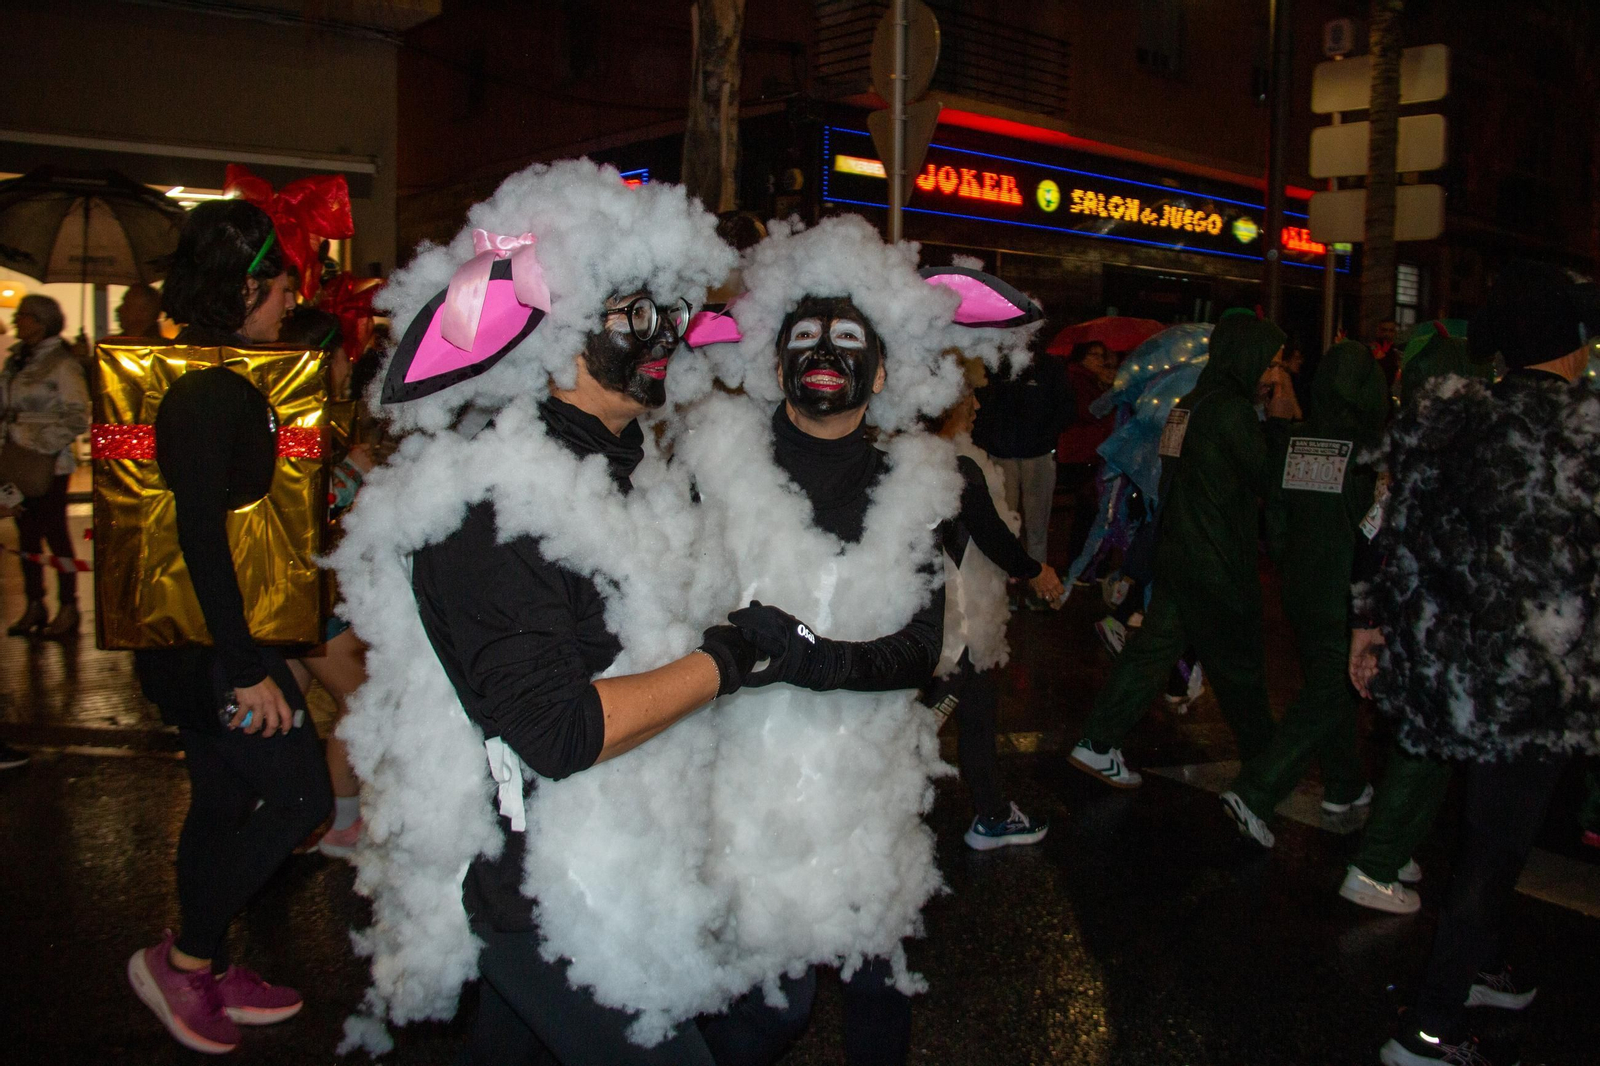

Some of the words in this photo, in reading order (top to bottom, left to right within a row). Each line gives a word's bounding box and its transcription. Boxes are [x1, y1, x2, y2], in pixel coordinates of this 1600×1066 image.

[915, 164, 1023, 206] JOKER
[1070, 189, 1140, 222] SALON
[1159, 205, 1223, 235] JUEGO
[1297, 460, 1334, 481] 110
